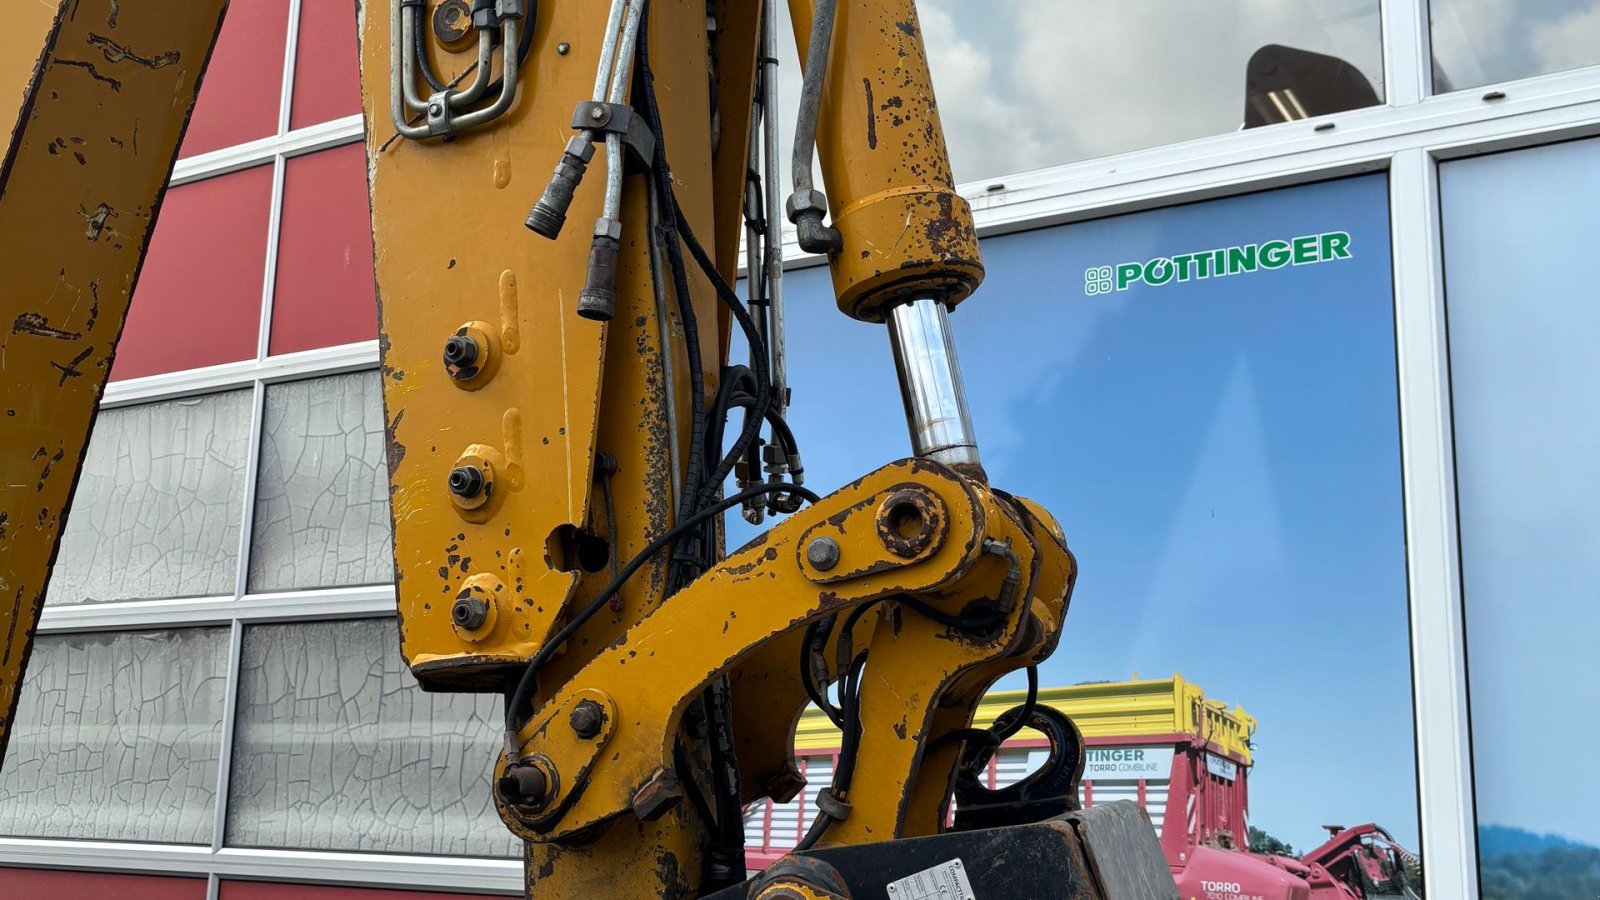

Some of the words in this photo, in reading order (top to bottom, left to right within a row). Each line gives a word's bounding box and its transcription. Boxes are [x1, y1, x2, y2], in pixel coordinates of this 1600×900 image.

[1116, 231, 1352, 290] PÖTTINGER
[1088, 763, 1117, 772] TORRO
[1118, 762, 1159, 772] COMBILINE
[1200, 880, 1241, 893] TORRO
